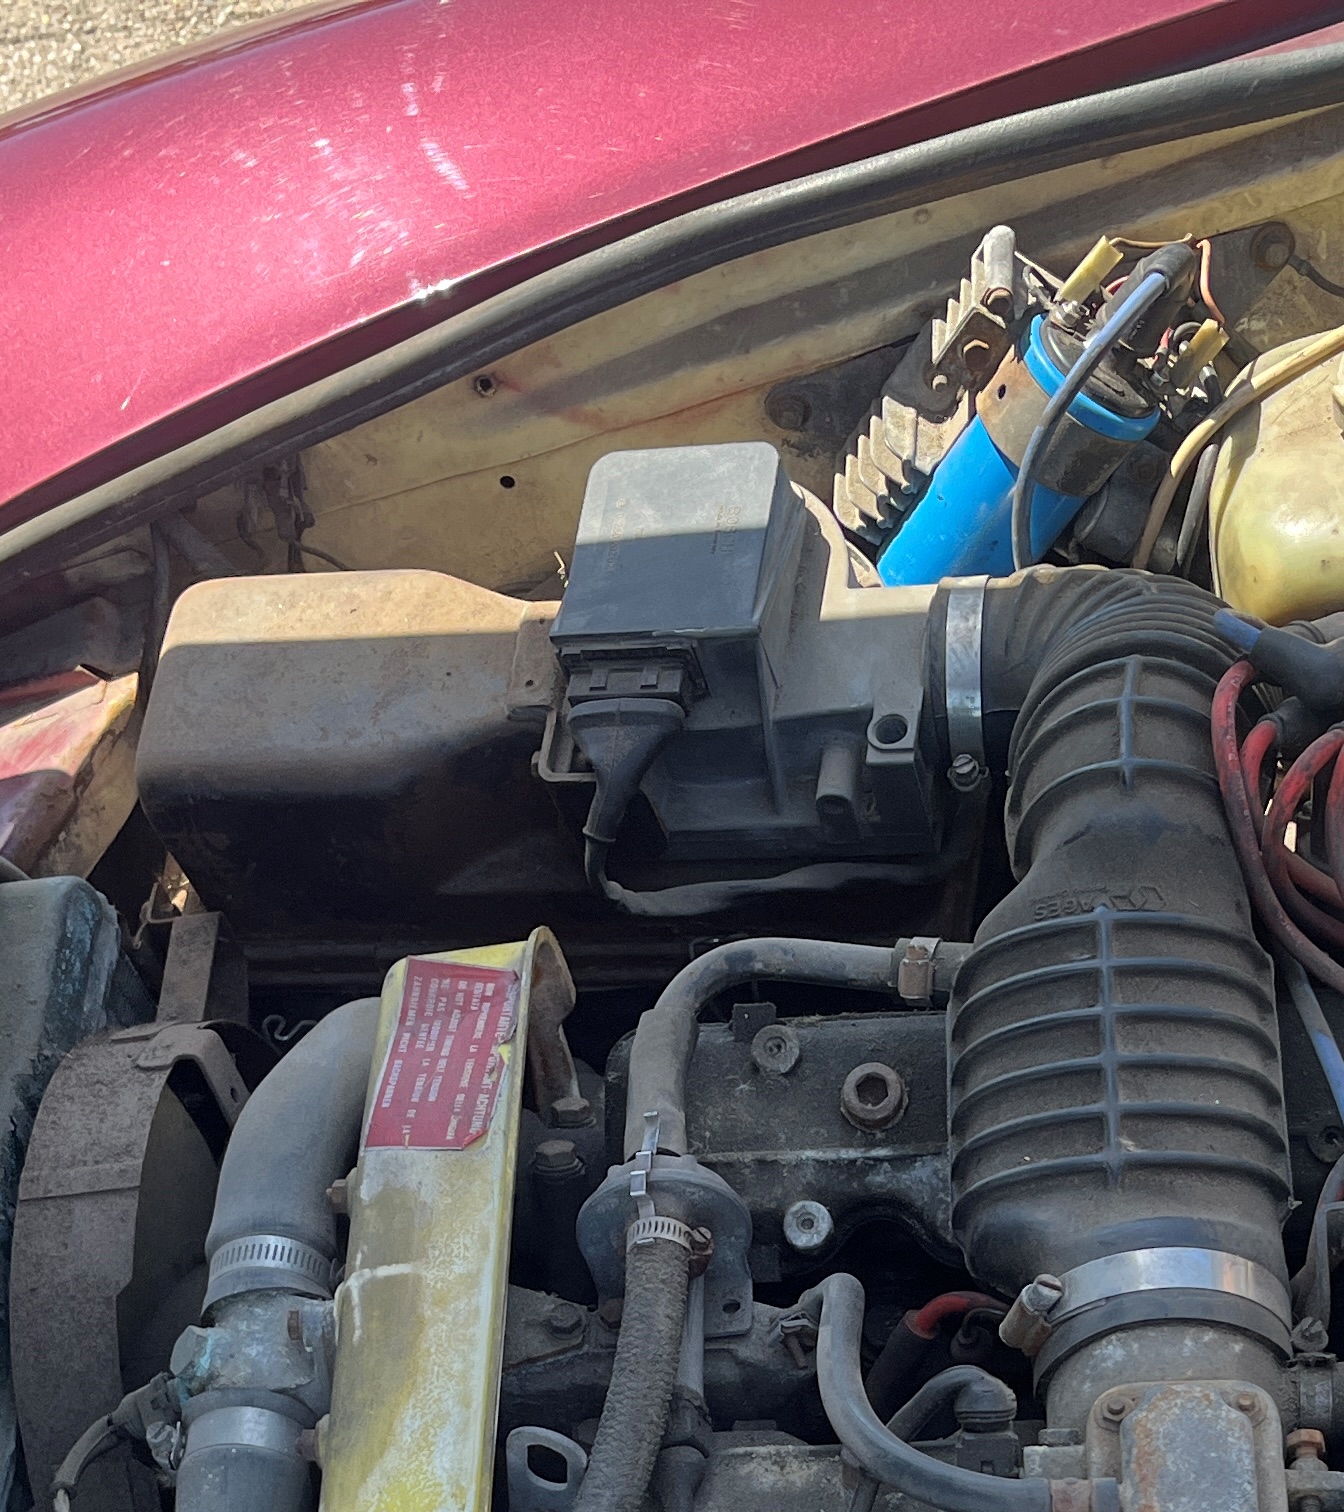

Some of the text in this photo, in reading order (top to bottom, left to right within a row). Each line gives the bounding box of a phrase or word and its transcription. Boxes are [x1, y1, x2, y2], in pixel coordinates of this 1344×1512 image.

[437, 997, 446, 1011] PAS
[470, 1044, 478, 1052] LA
[422, 1058, 430, 1066] LA
